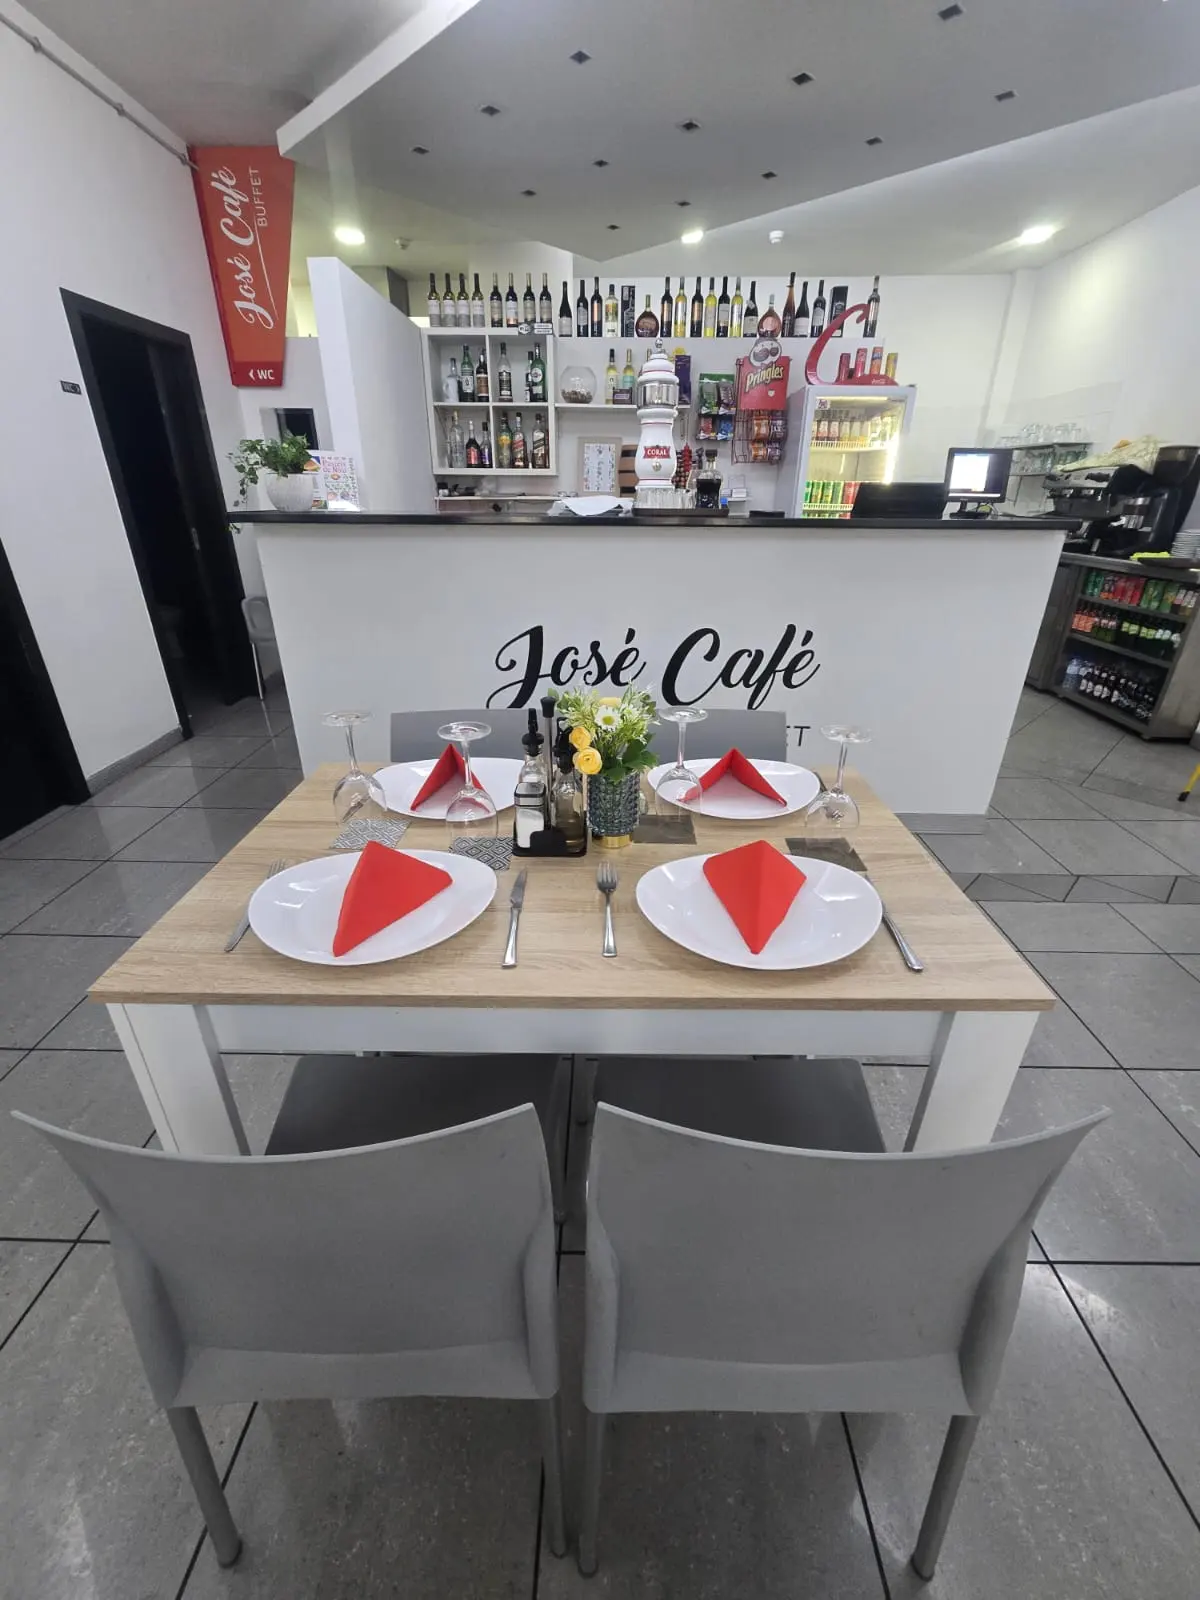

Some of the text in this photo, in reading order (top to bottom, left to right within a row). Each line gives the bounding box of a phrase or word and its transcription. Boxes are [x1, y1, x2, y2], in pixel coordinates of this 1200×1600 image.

[248, 165, 268, 227] BUFFET
[210, 165, 274, 329] José Café
[257, 369, 274, 380] WC
[745, 363, 784, 392] Pringles
[486, 624, 820, 710] José Café
